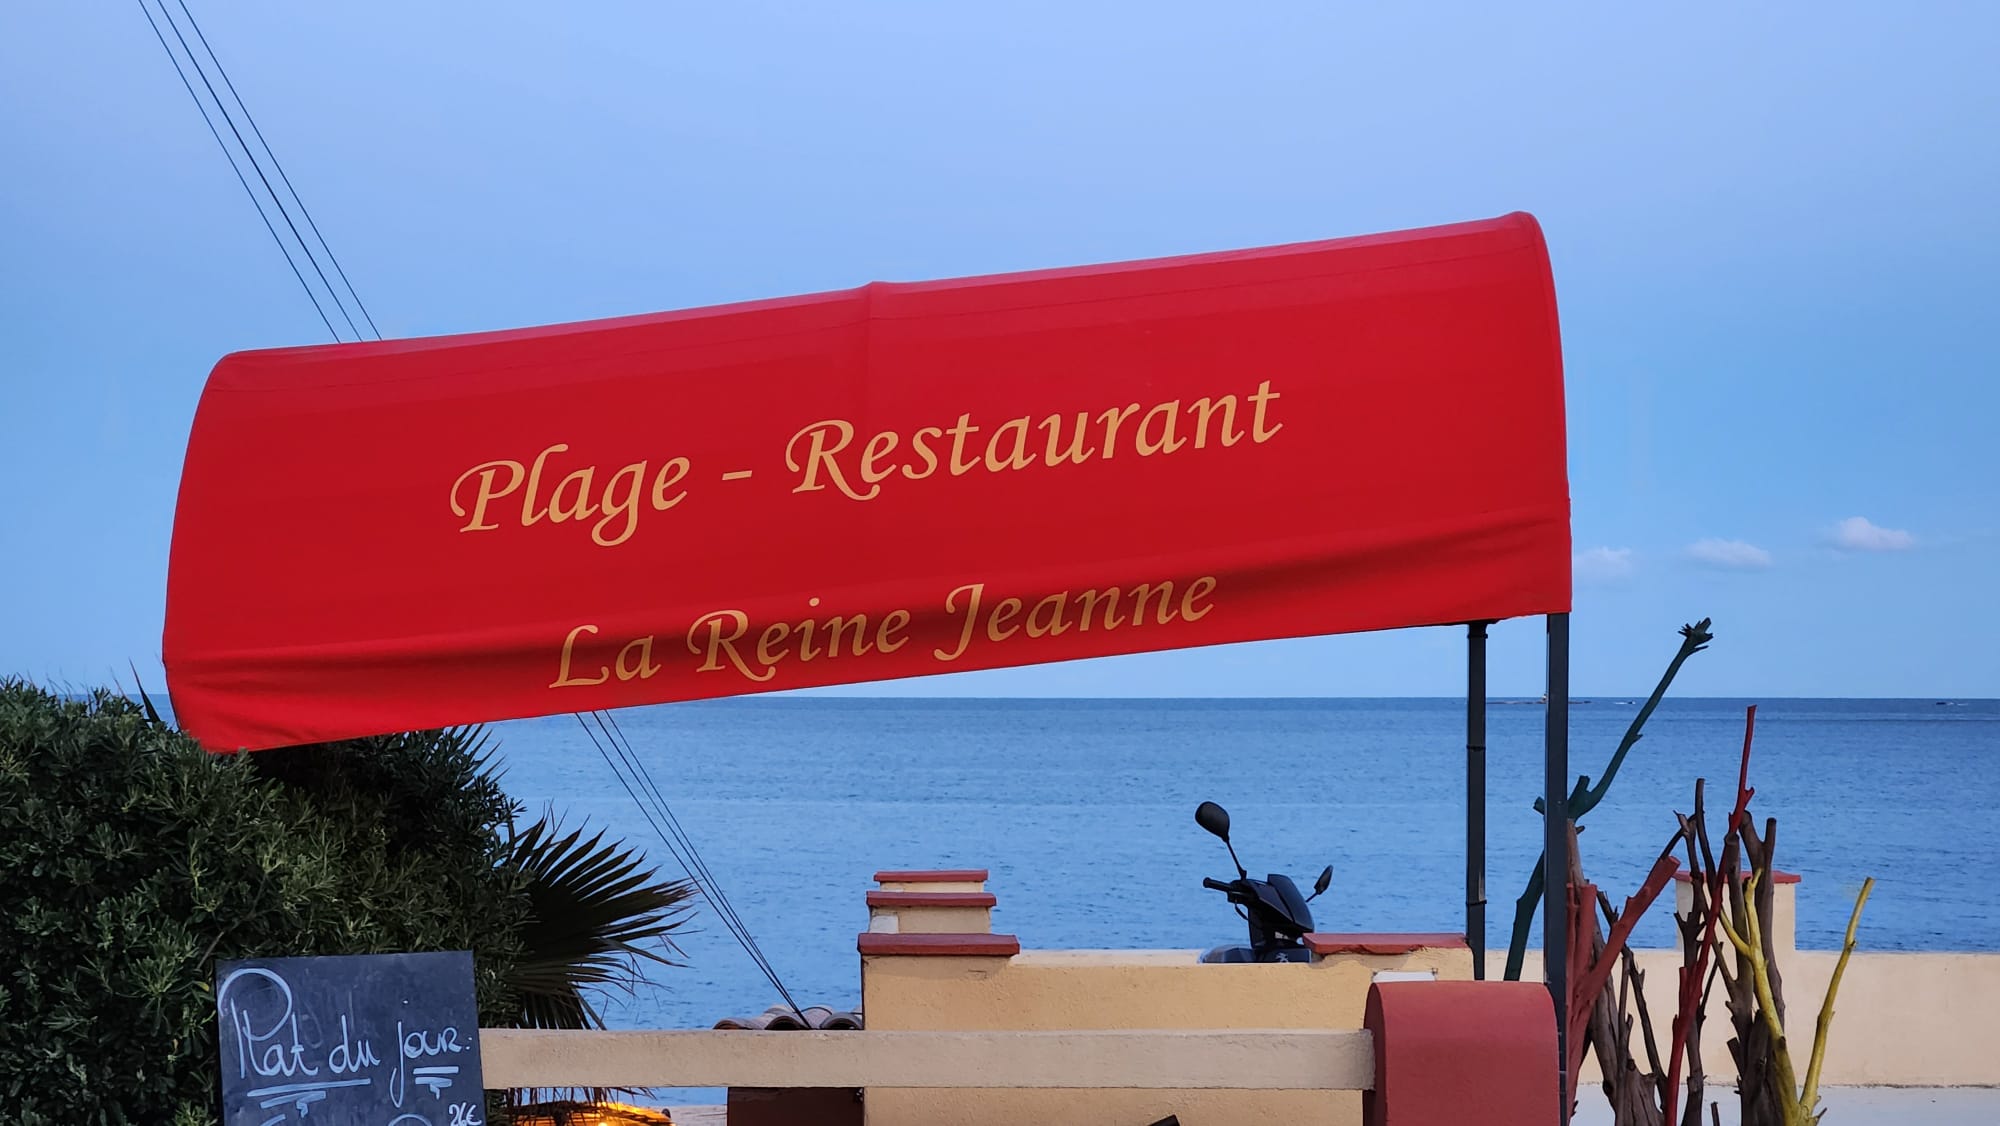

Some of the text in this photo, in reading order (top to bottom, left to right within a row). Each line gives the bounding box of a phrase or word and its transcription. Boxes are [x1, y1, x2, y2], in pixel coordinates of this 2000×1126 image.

[450, 380, 1283, 547] Plage - Restaurant
[549, 576, 1217, 689] La Reine Jeanne
[217, 968, 319, 1079] Plat
[328, 1014, 381, 1074] du
